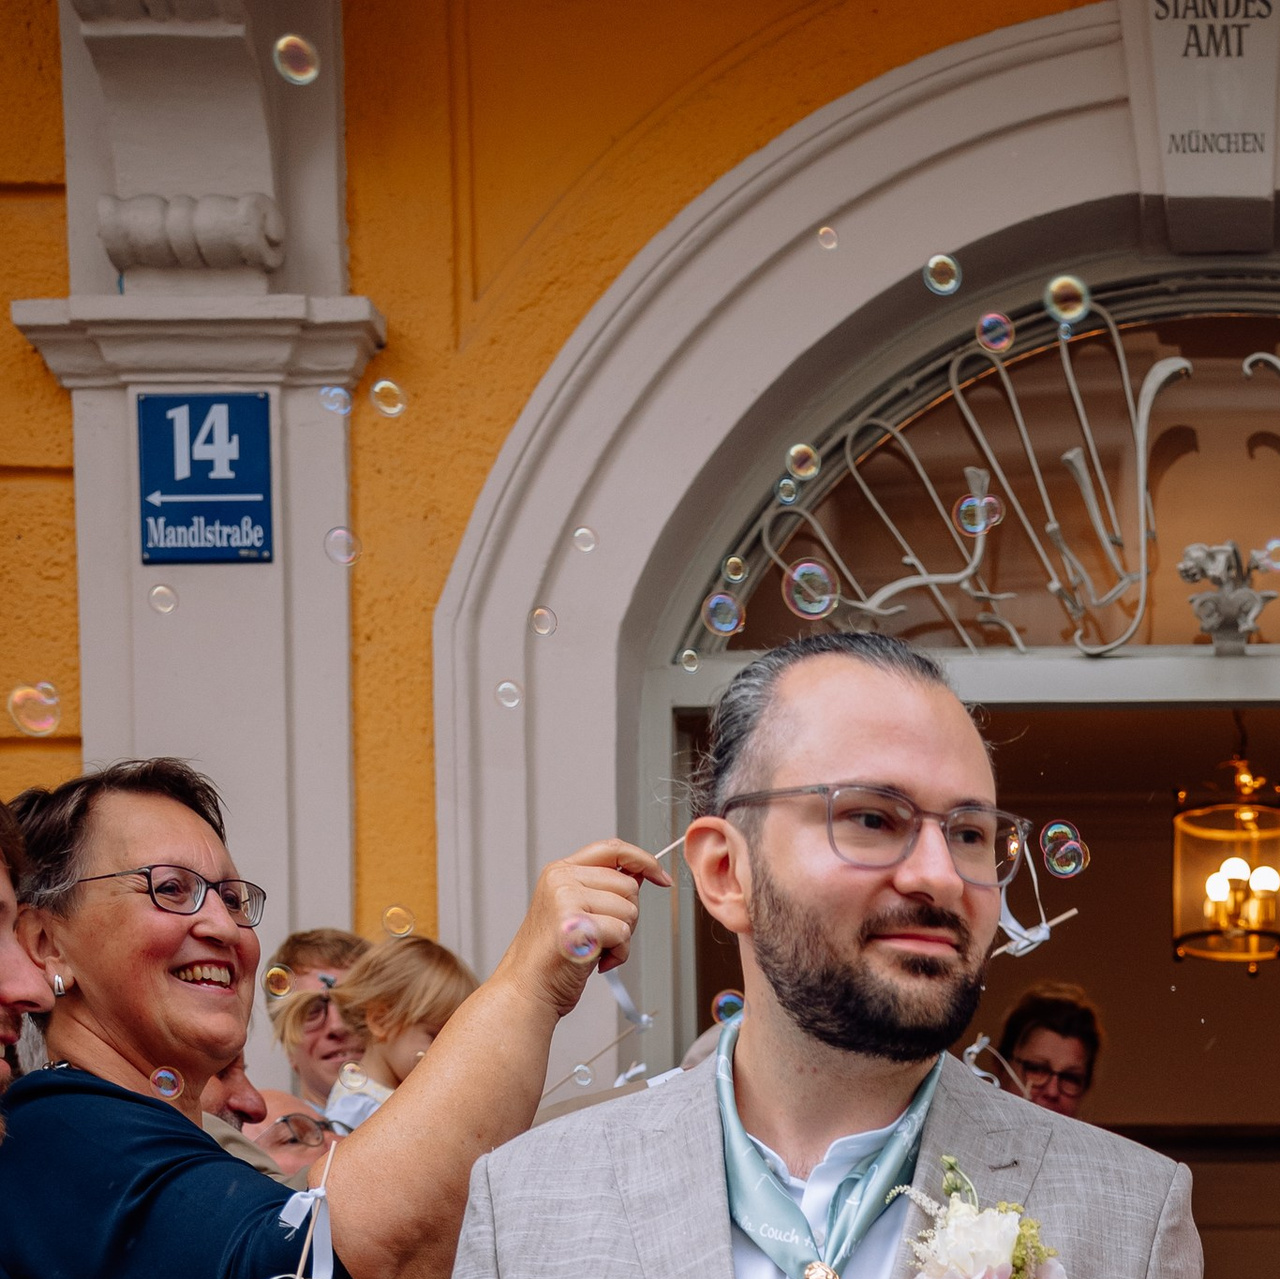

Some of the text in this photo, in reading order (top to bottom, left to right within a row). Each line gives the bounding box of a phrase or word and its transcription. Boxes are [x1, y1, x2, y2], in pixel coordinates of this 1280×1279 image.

[1182, 23, 1251, 58] AMT
[1167, 130, 1266, 154] MÜNCHEN
[166, 403, 240, 481] 14
[146, 515, 264, 548] Mandlstraße
